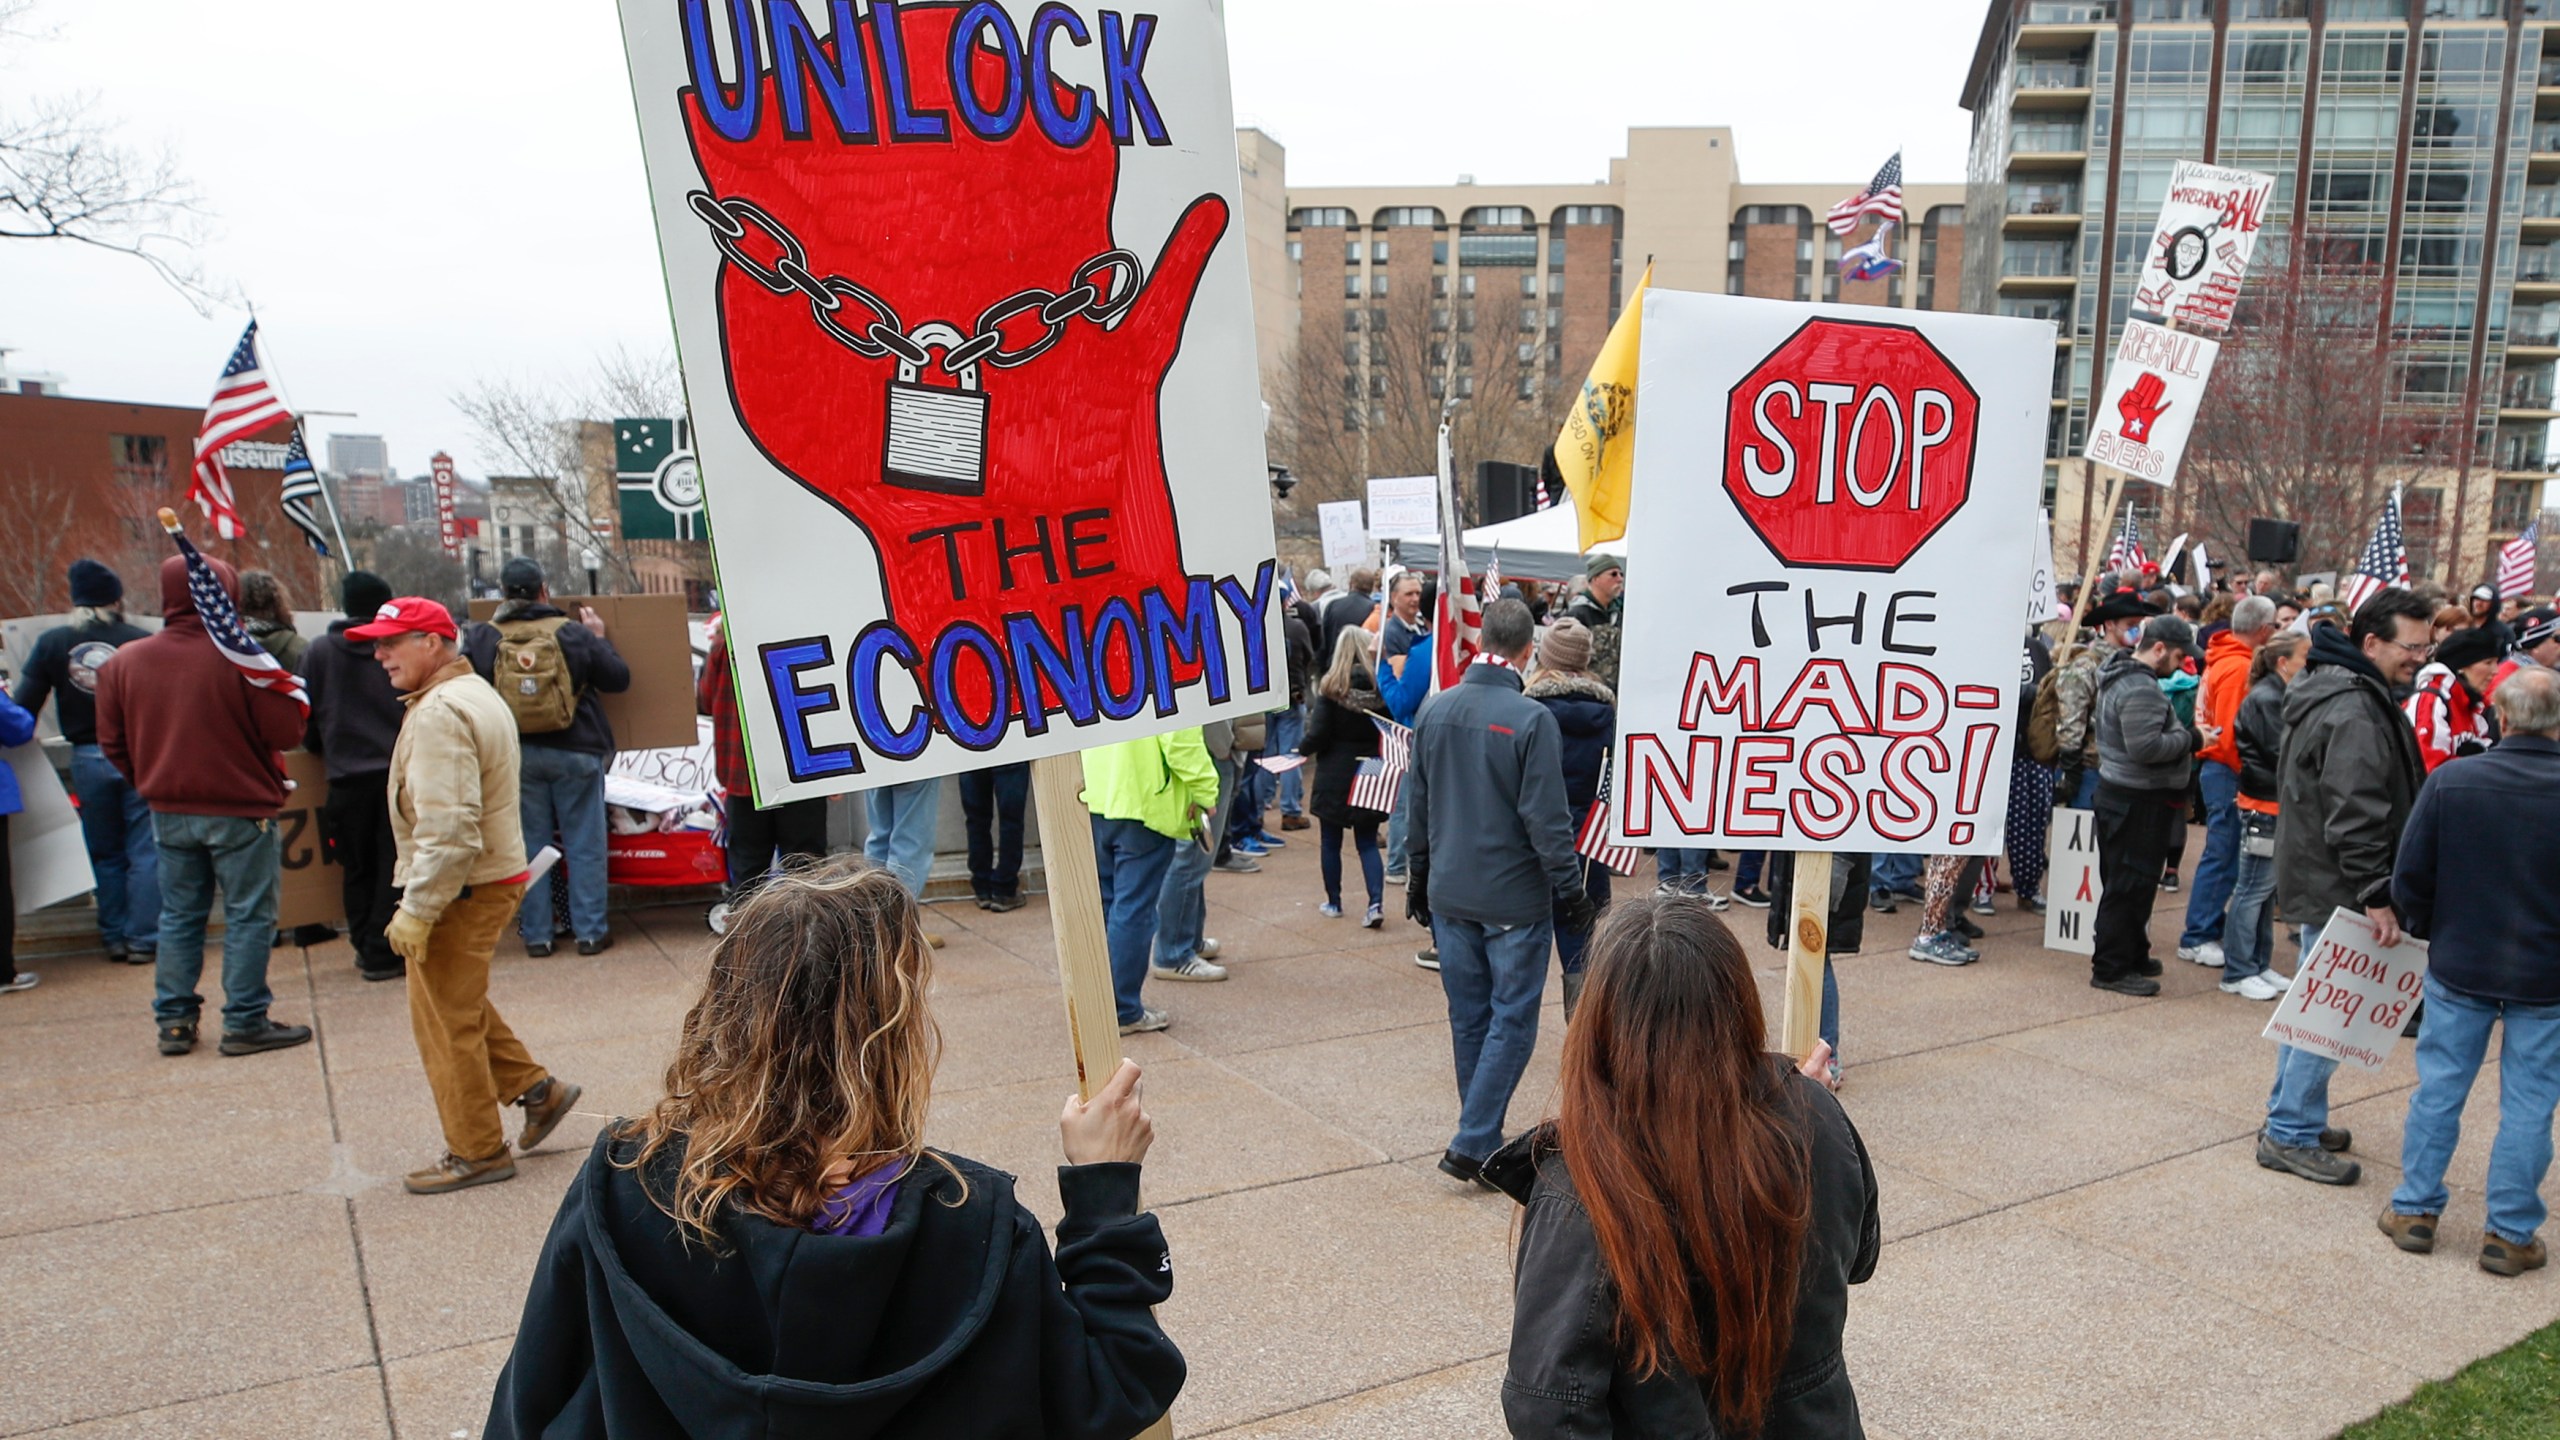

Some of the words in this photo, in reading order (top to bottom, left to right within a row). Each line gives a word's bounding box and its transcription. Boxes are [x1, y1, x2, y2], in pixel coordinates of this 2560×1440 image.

[679, 0, 1171, 147] UNLOCK
[2221, 182, 2270, 232] BALL
[2119, 322, 2200, 379] RECALL
[1742, 380, 1954, 510] STOP
[2091, 429, 2164, 477] EVERS
[908, 508, 1116, 601] THE
[1726, 581, 1938, 656] THE
[757, 559, 1278, 783] ECONOMY
[1678, 651, 2000, 738] MAD-
[1623, 722, 2000, 846] NESS!
[2308, 940, 2389, 984] work!
[2397, 971, 2424, 1000] to
[2300, 977, 2364, 1028] back
[2370, 999, 2408, 1029] go
